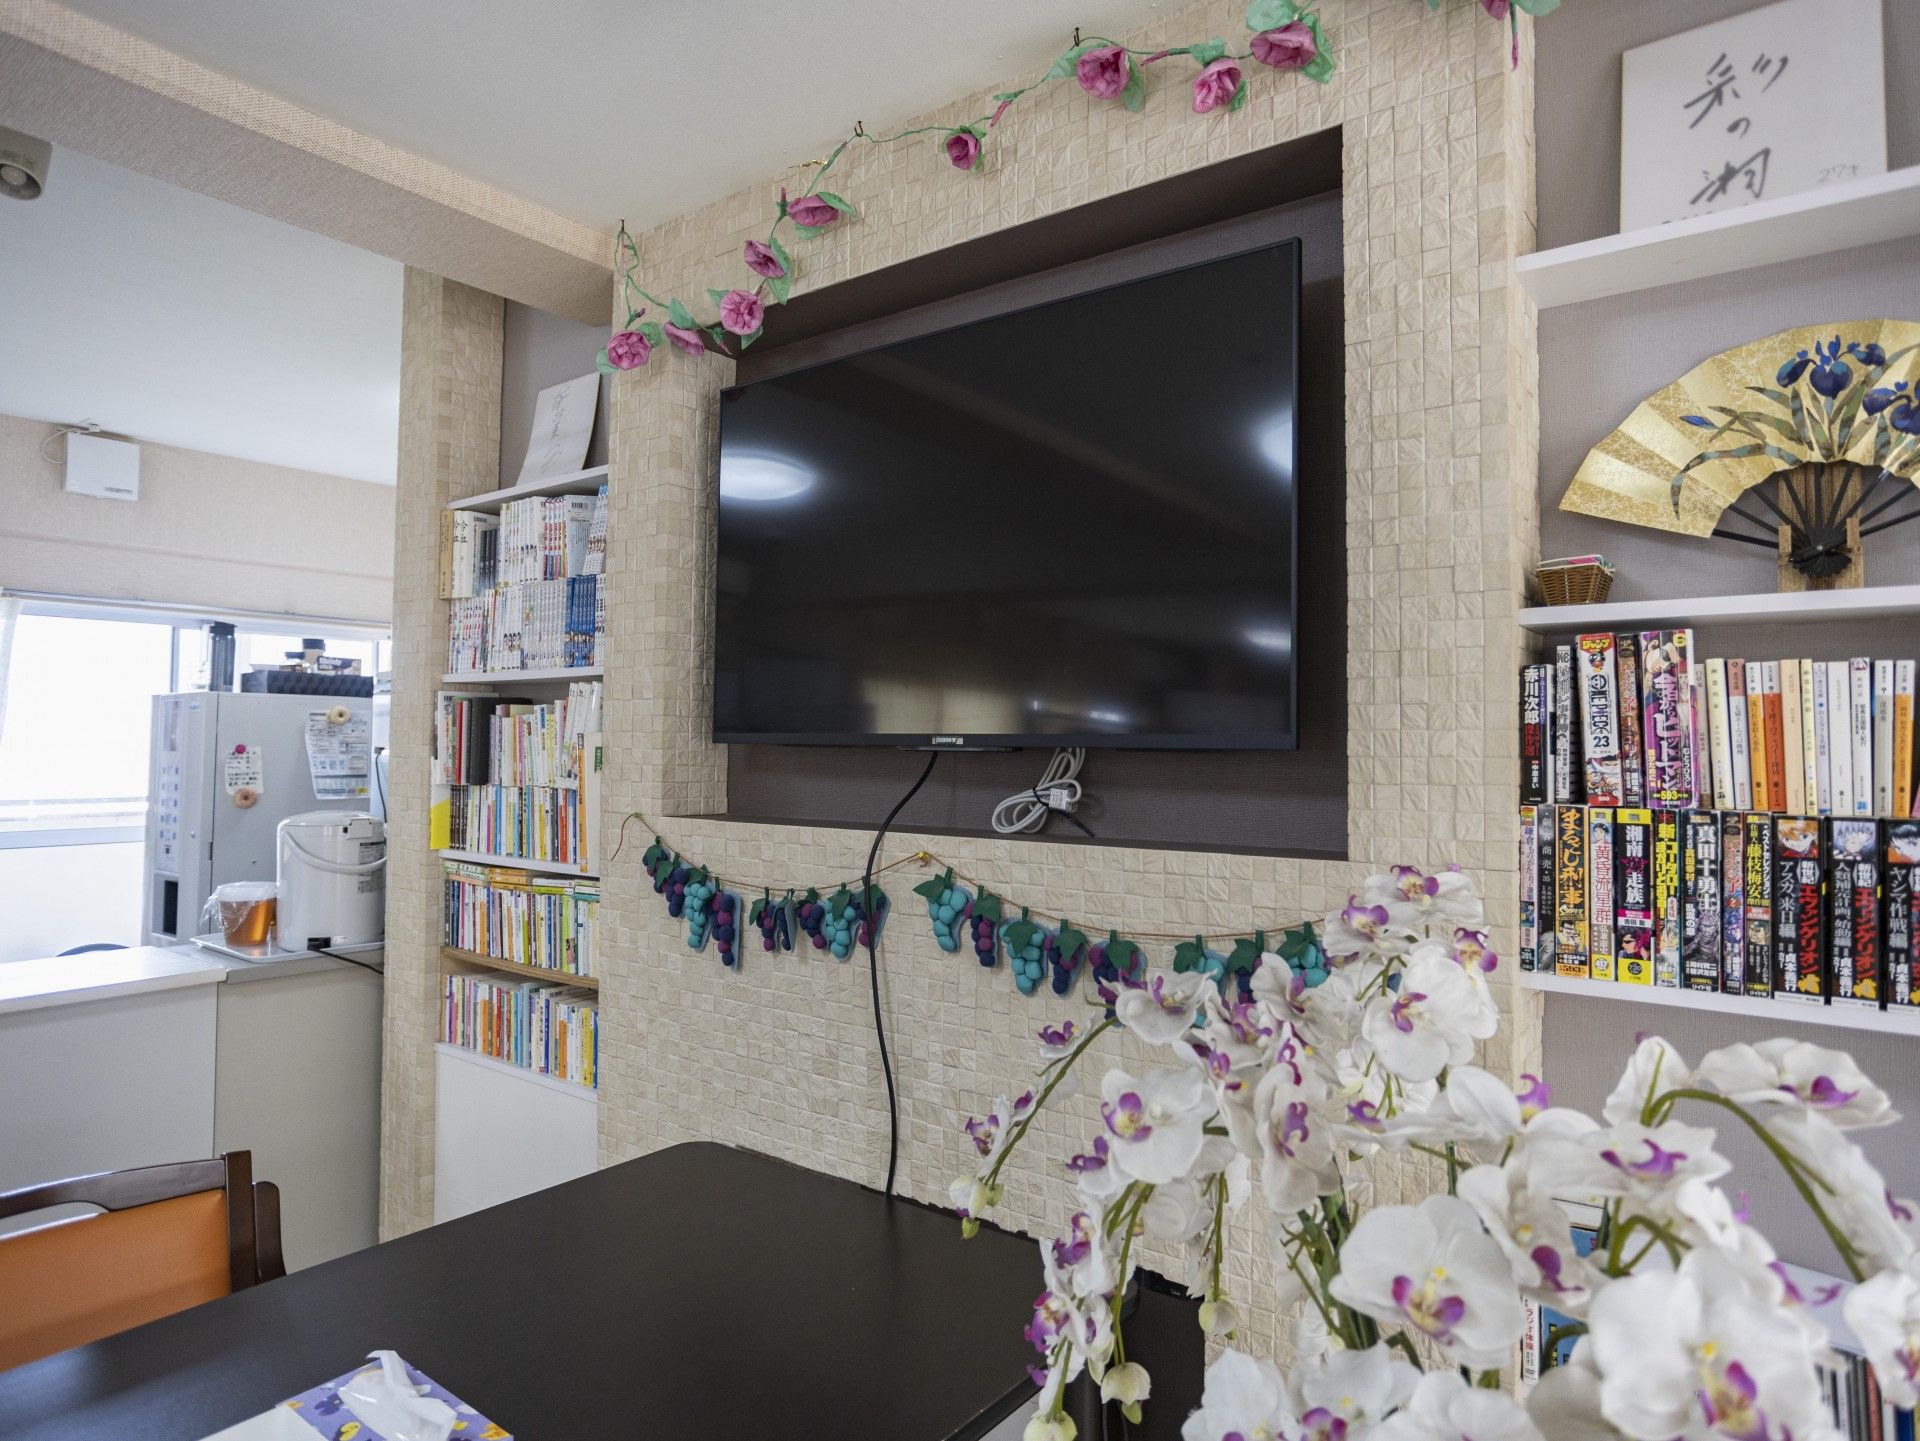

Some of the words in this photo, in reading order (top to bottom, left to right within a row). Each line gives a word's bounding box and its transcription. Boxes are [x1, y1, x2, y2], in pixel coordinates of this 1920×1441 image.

[1524, 668, 1540, 724] 赤川次郎
[1593, 735, 1610, 748] 23
[1595, 844, 1611, 924] 黄昏流星群
[1625, 825, 1645, 904] 湘南爆走族
[1696, 825, 1718, 911] 真田十勇士
[1779, 861, 1796, 939] アスカ、来日編
[1801, 861, 1815, 885] 新世紀
[1857, 863, 1872, 888] 新世紀
[1799, 884, 1819, 975] エヴァンゲリオン
[1855, 887, 1877, 980] エヴァンゲリオン
[1889, 866, 1908, 950] ヤシマ作戦編
